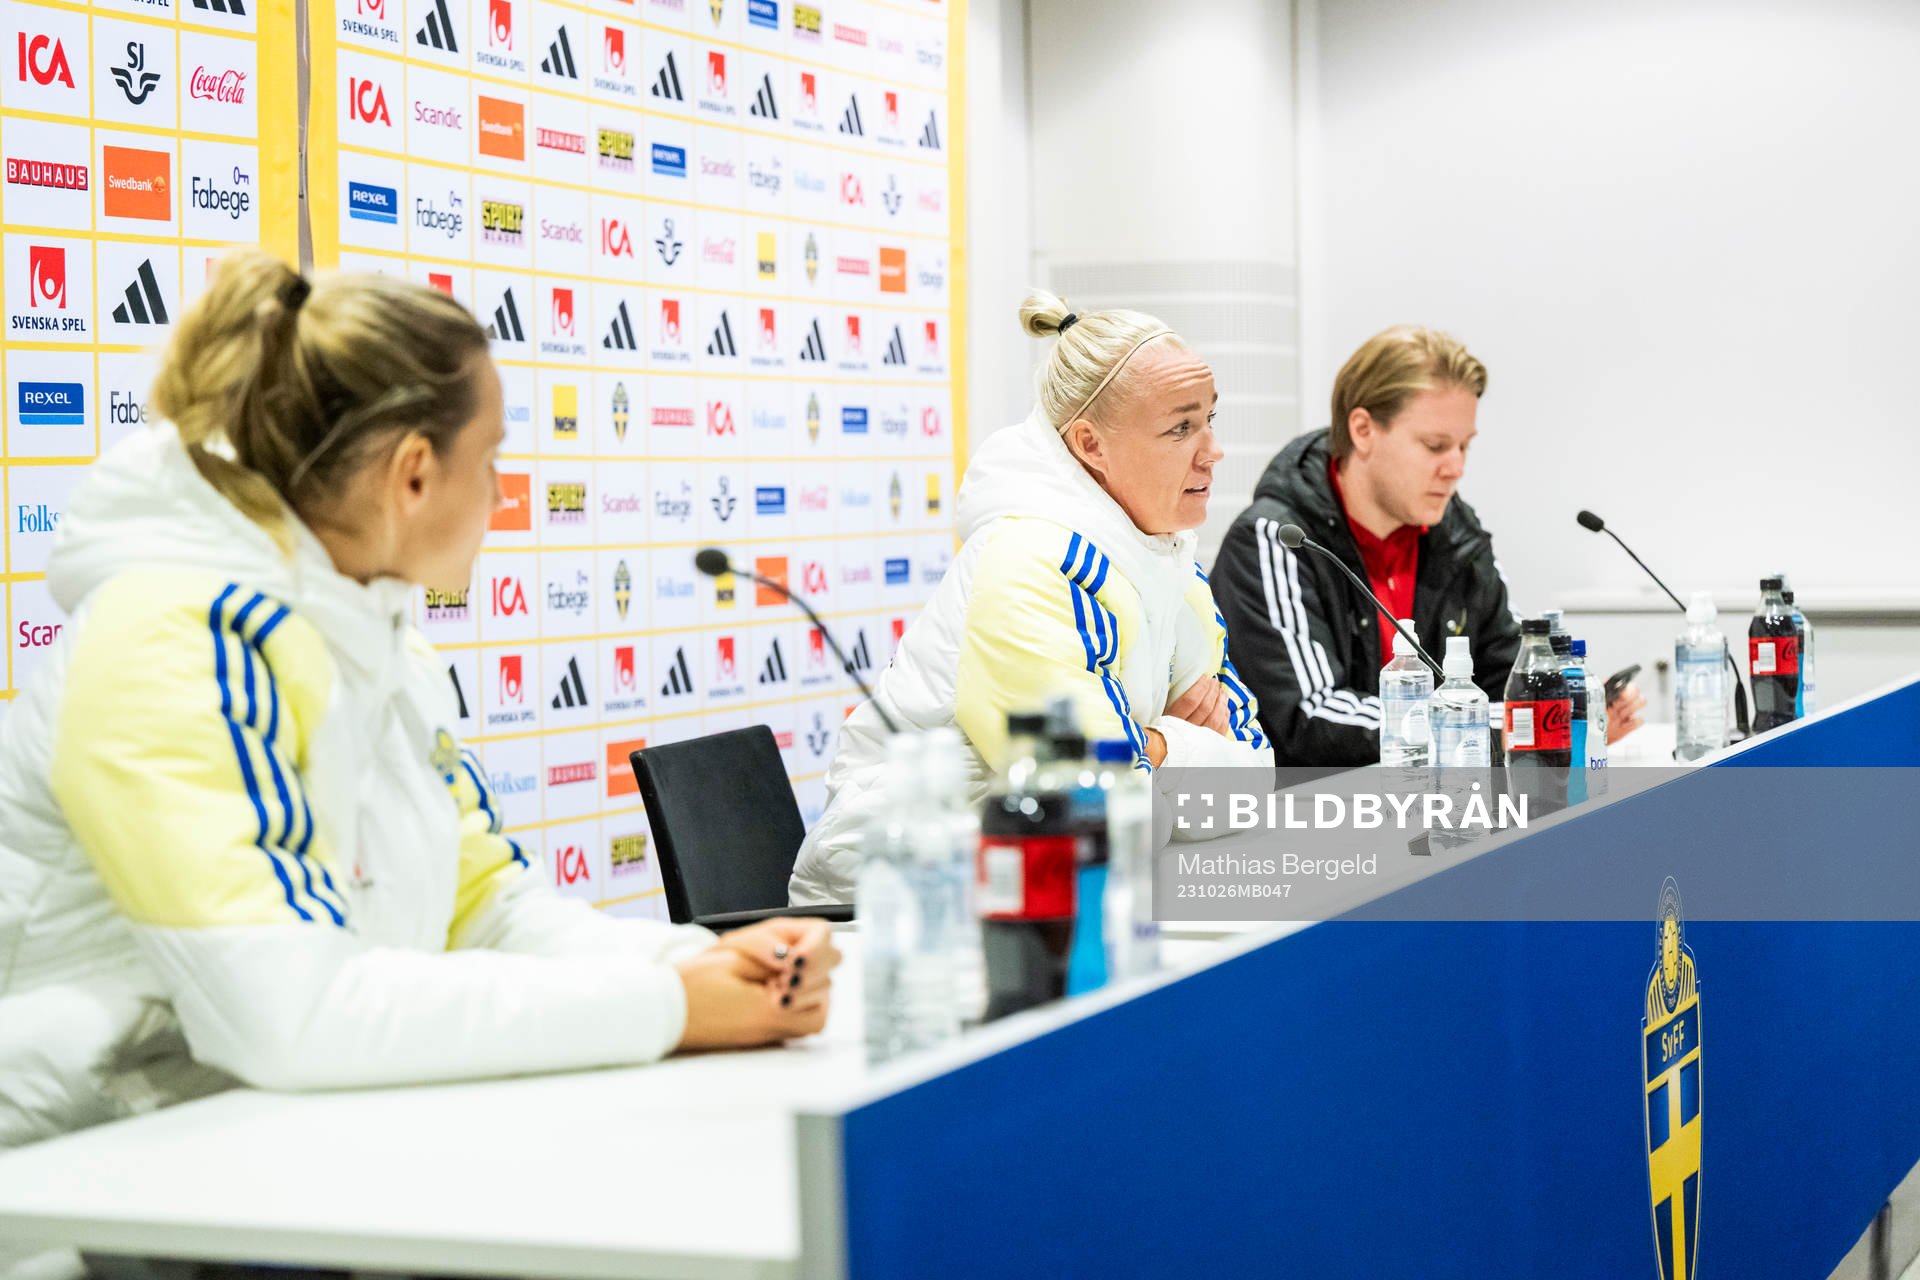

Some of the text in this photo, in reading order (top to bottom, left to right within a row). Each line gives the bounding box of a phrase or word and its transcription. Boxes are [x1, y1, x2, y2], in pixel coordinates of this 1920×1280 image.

[343, 19, 398, 43] SVENSKA SPEL
[18, 31, 75, 88] ICA
[127, 42, 145, 72] SJ
[190, 65, 248, 105] Coca-Cola
[350, 77, 391, 127] ICA
[415, 101, 463, 130] Scandic
[536, 127, 586, 154] BAUHAUS
[7, 158, 88, 191] BAUHAUS
[109, 175, 153, 192] Swedbank
[192, 176, 250, 220] Fabege
[416, 198, 463, 239] Fabege
[482, 200, 523, 235] SPORT
[541, 218, 583, 244] Scandic
[601, 217, 634, 259] ICA
[12, 315, 86, 332] SVENSKA SPEL
[110, 391, 149, 424] Fabe
[707, 400, 736, 436] ICA
[18, 504, 61, 533] Folk
[492, 576, 528, 617] ICA
[556, 845, 590, 887] ICA
[1661, 1020, 1685, 1063] SvFF
